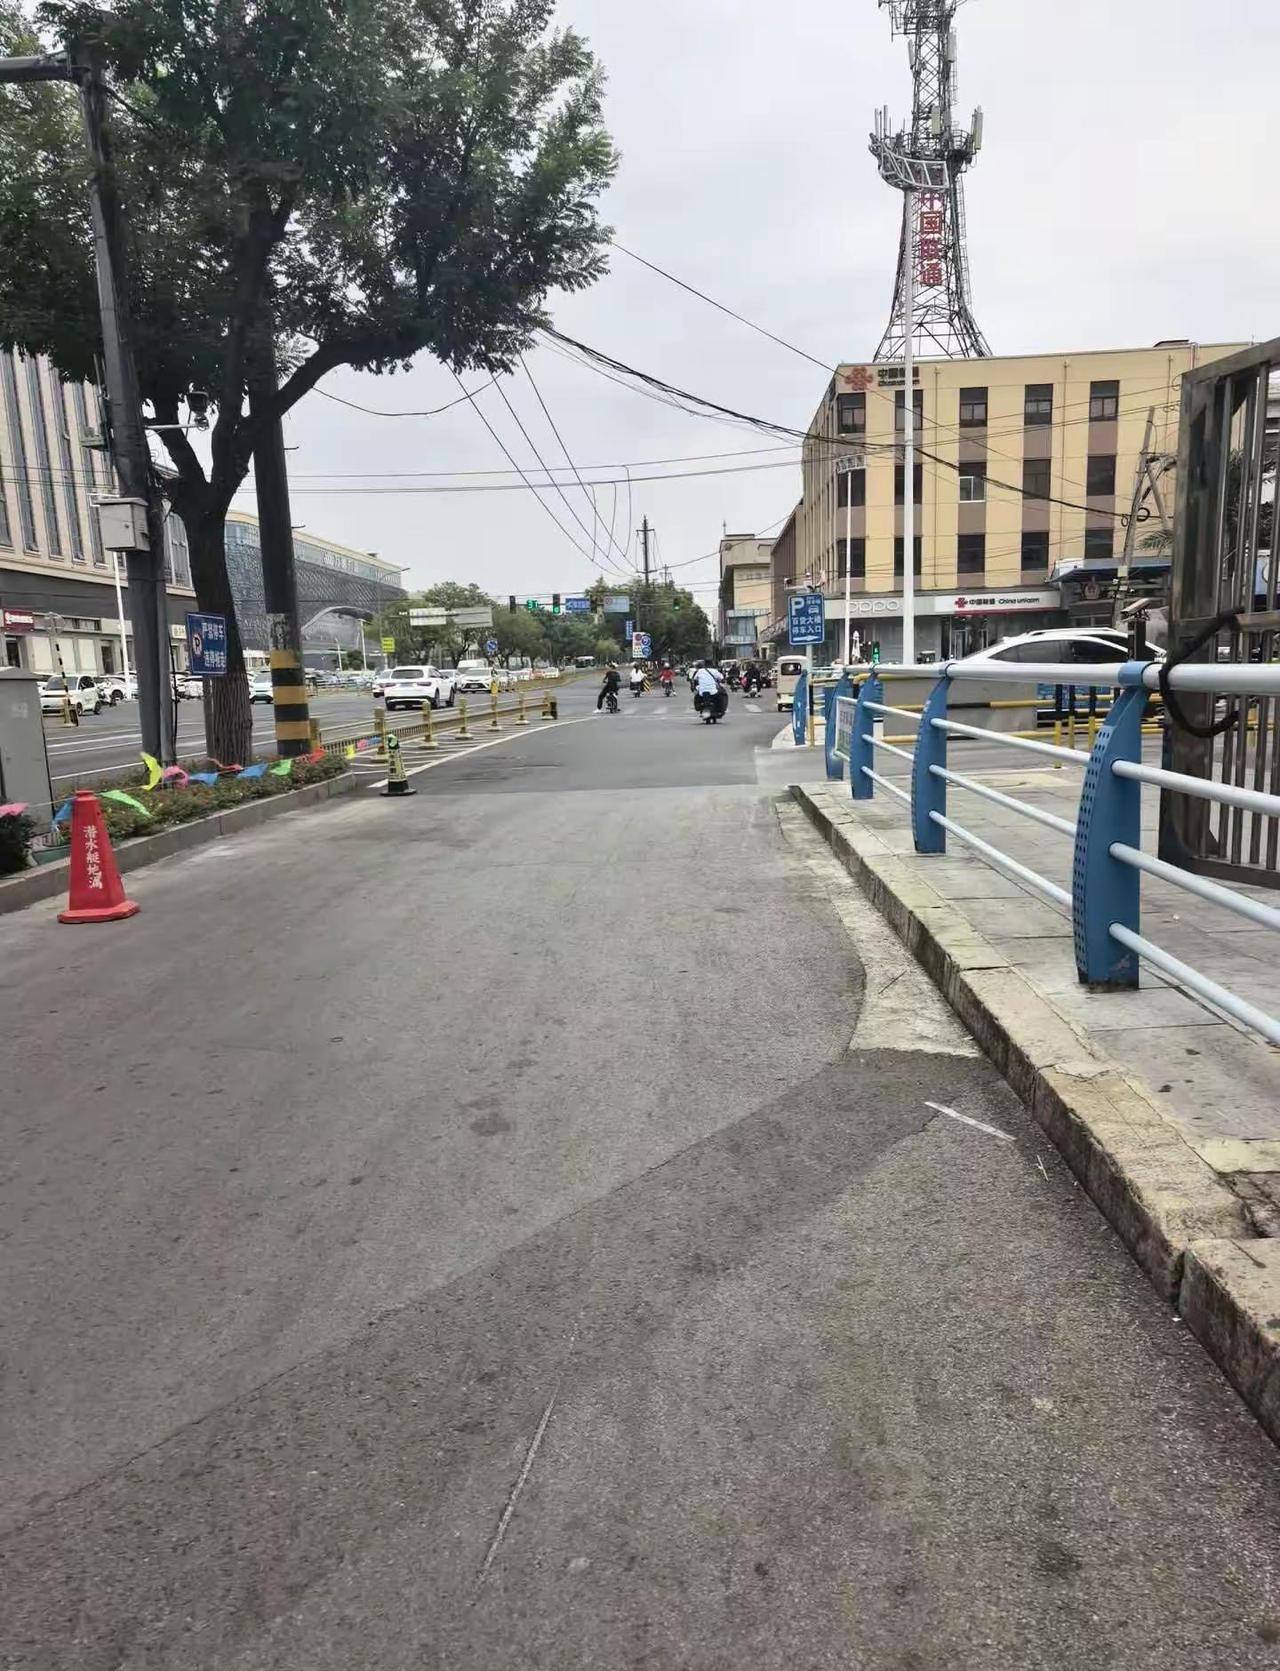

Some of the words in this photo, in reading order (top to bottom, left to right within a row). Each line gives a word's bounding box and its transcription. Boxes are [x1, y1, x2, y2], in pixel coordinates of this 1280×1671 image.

[791, 597, 804, 616] P
[792, 625, 822, 634] 停车入口
[83, 825, 103, 889] 潜水艇地漏
